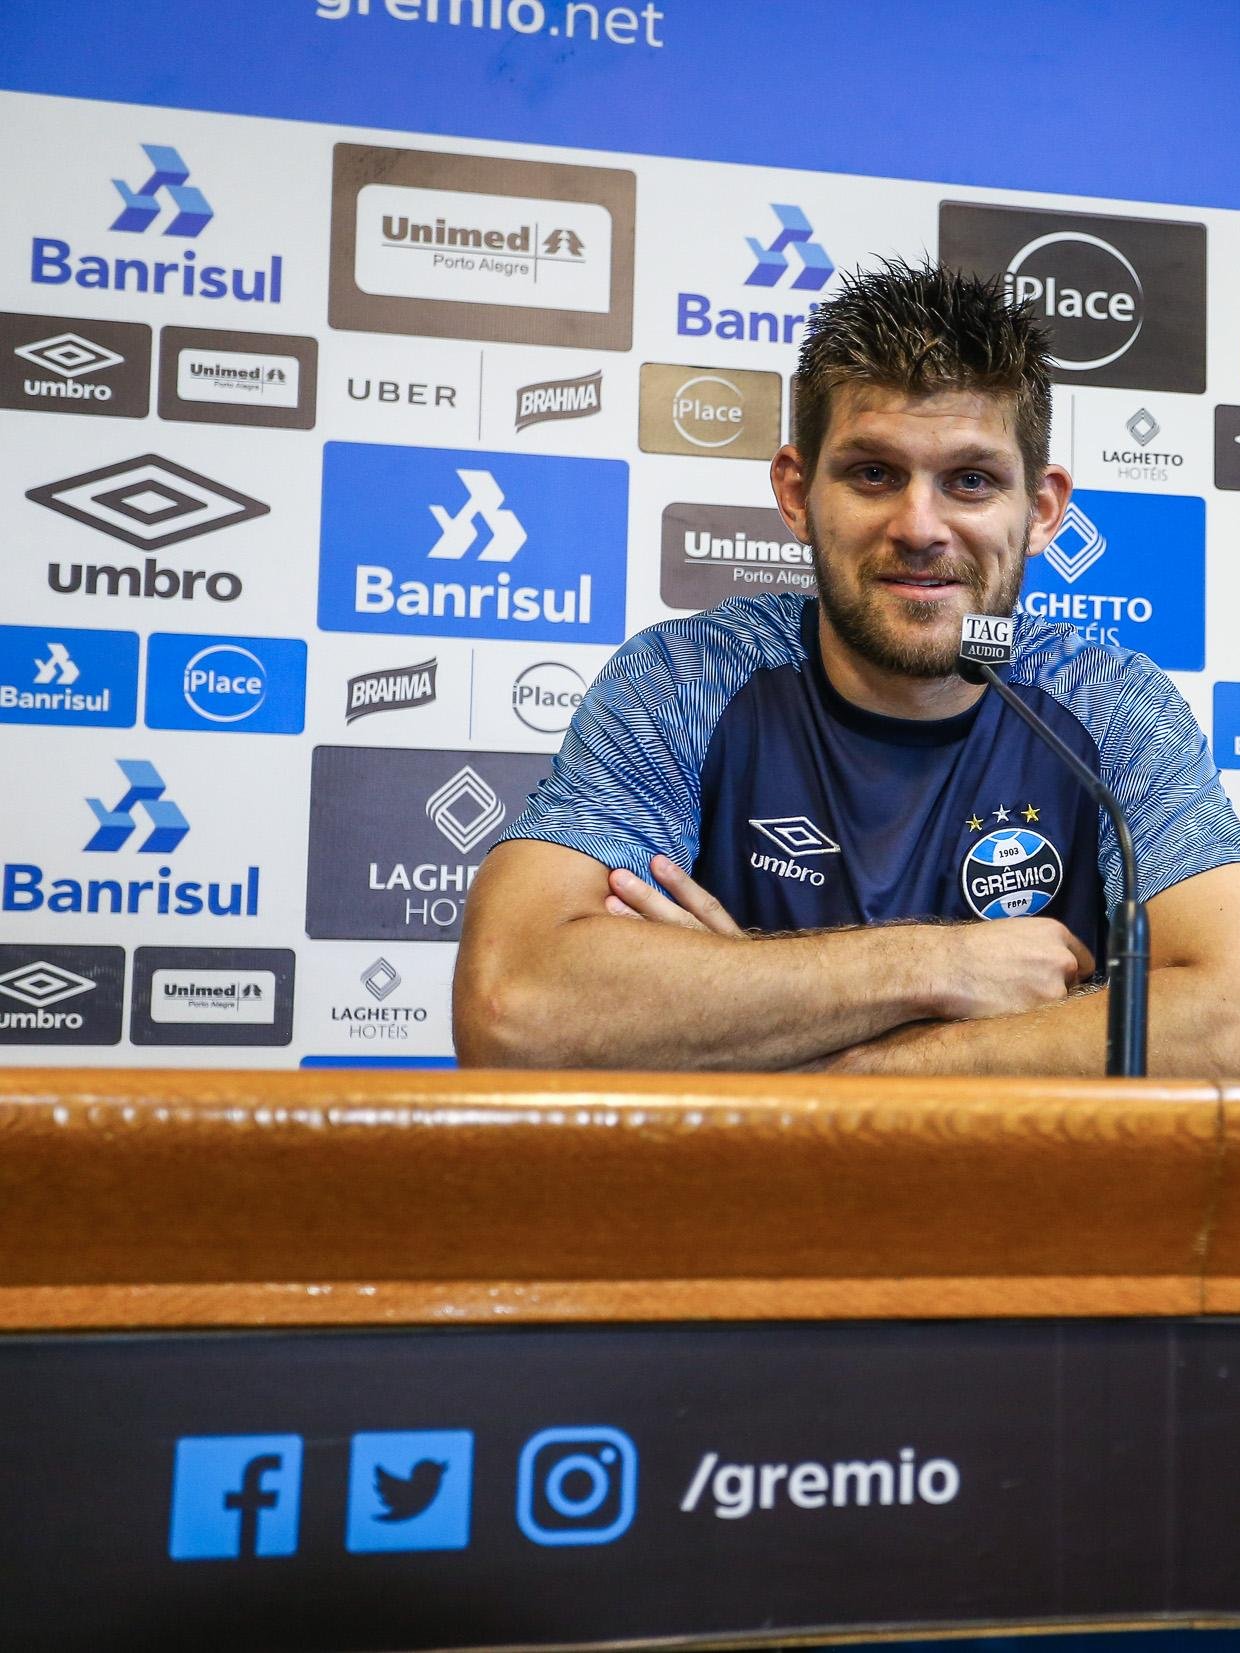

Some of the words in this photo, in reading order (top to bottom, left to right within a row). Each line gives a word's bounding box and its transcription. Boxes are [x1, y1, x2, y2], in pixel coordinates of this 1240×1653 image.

[382, 215, 530, 252] Unimed
[30, 236, 283, 304] Banrisul
[433, 254, 475, 271] Porto
[479, 257, 530, 277] Alegre
[190, 363, 260, 379] Unimed
[23, 378, 112, 401] umbro
[347, 377, 457, 408] UBER
[519, 383, 598, 417] BRAHMA
[672, 398, 742, 423] iPlace
[1102, 450, 1183, 467] LAGHETTO
[1117, 466, 1168, 482] HOTÉIS
[47, 558, 243, 602] umbro
[733, 567, 774, 584] Porto
[354, 564, 591, 624] Banrisul
[966, 617, 1009, 643] TAG
[968, 644, 1005, 658] AUDIO
[183, 669, 262, 695] iPlace
[351, 671, 432, 709] BRAHMA
[511, 682, 584, 707] iPlace
[0, 685, 110, 712] Banrisul
[998, 847, 1019, 859] 1903
[750, 852, 825, 888] umbro
[971, 867, 1056, 898] GRÊMIO
[2, 864, 260, 916] Banrisul
[1007, 897, 1027, 909] FBPA
[164, 983, 236, 997] Unimed
[331, 1007, 427, 1022] LAGHETTO
[349, 1023, 409, 1040] HOTÉIS
[680, 1448, 960, 1520] /gremio
